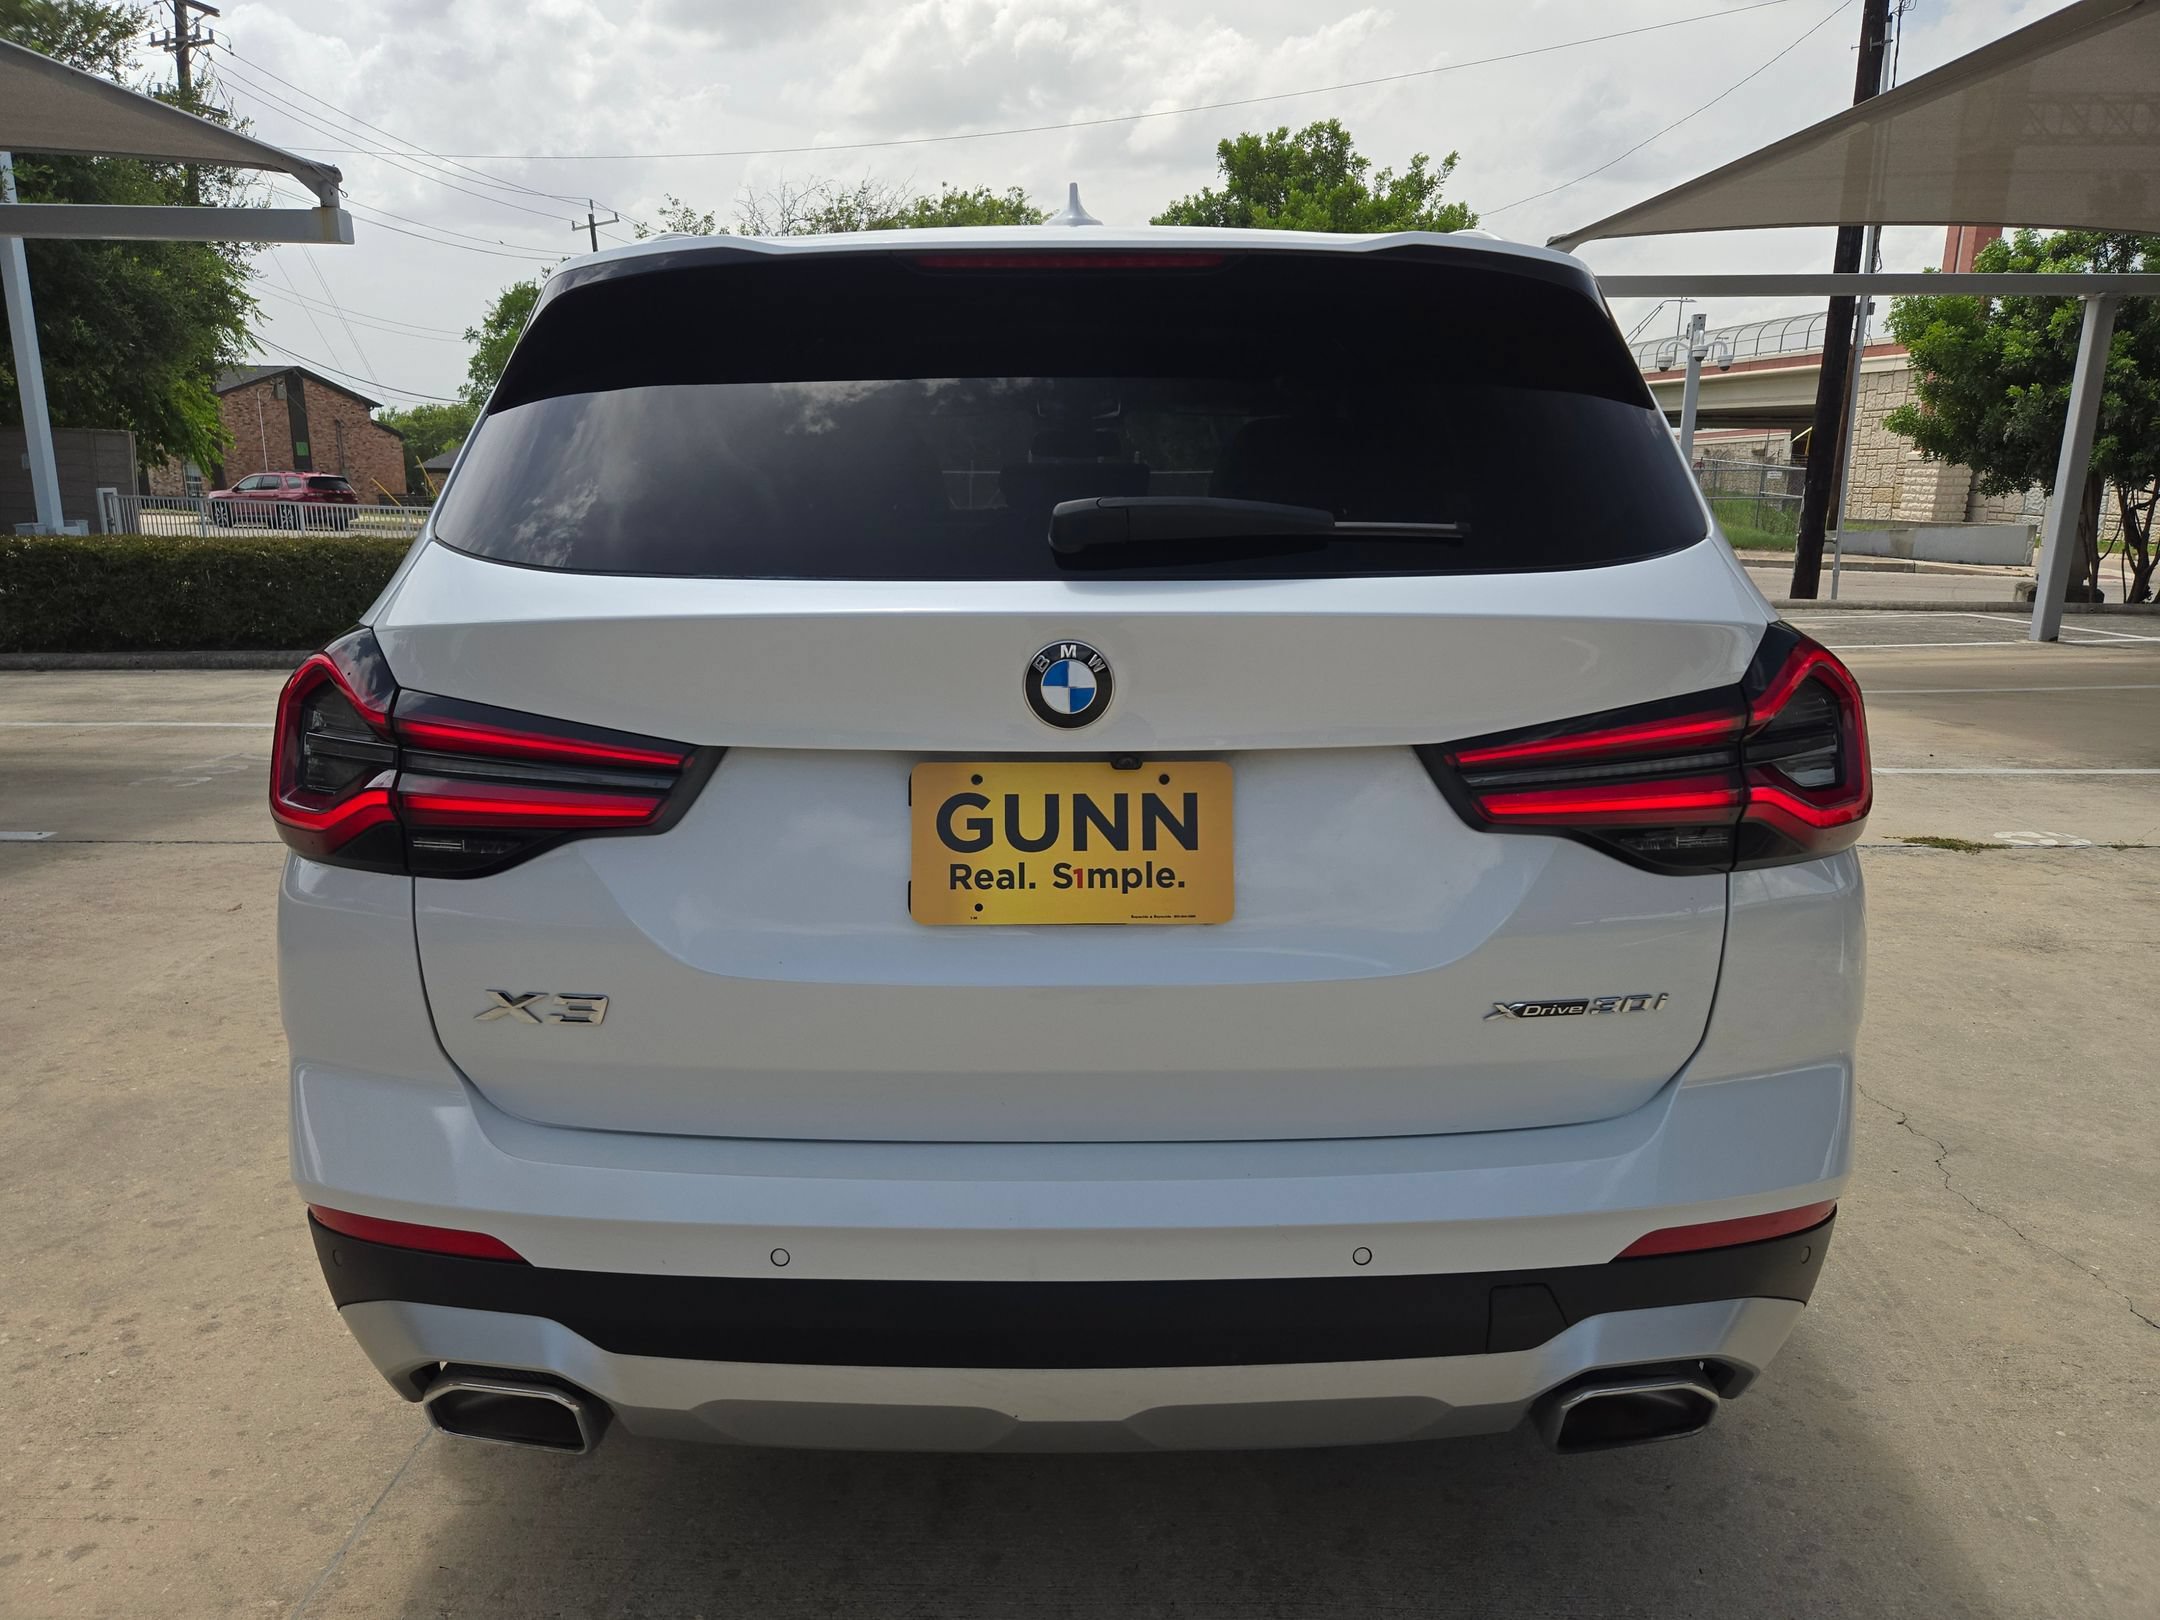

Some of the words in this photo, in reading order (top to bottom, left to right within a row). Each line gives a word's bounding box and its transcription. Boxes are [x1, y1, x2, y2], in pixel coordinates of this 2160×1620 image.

[1032, 644, 1106, 673] BMW
[936, 792, 1198, 853] GUNN
[949, 861, 1036, 890] Real.
[473, 988, 610, 1025] X3
